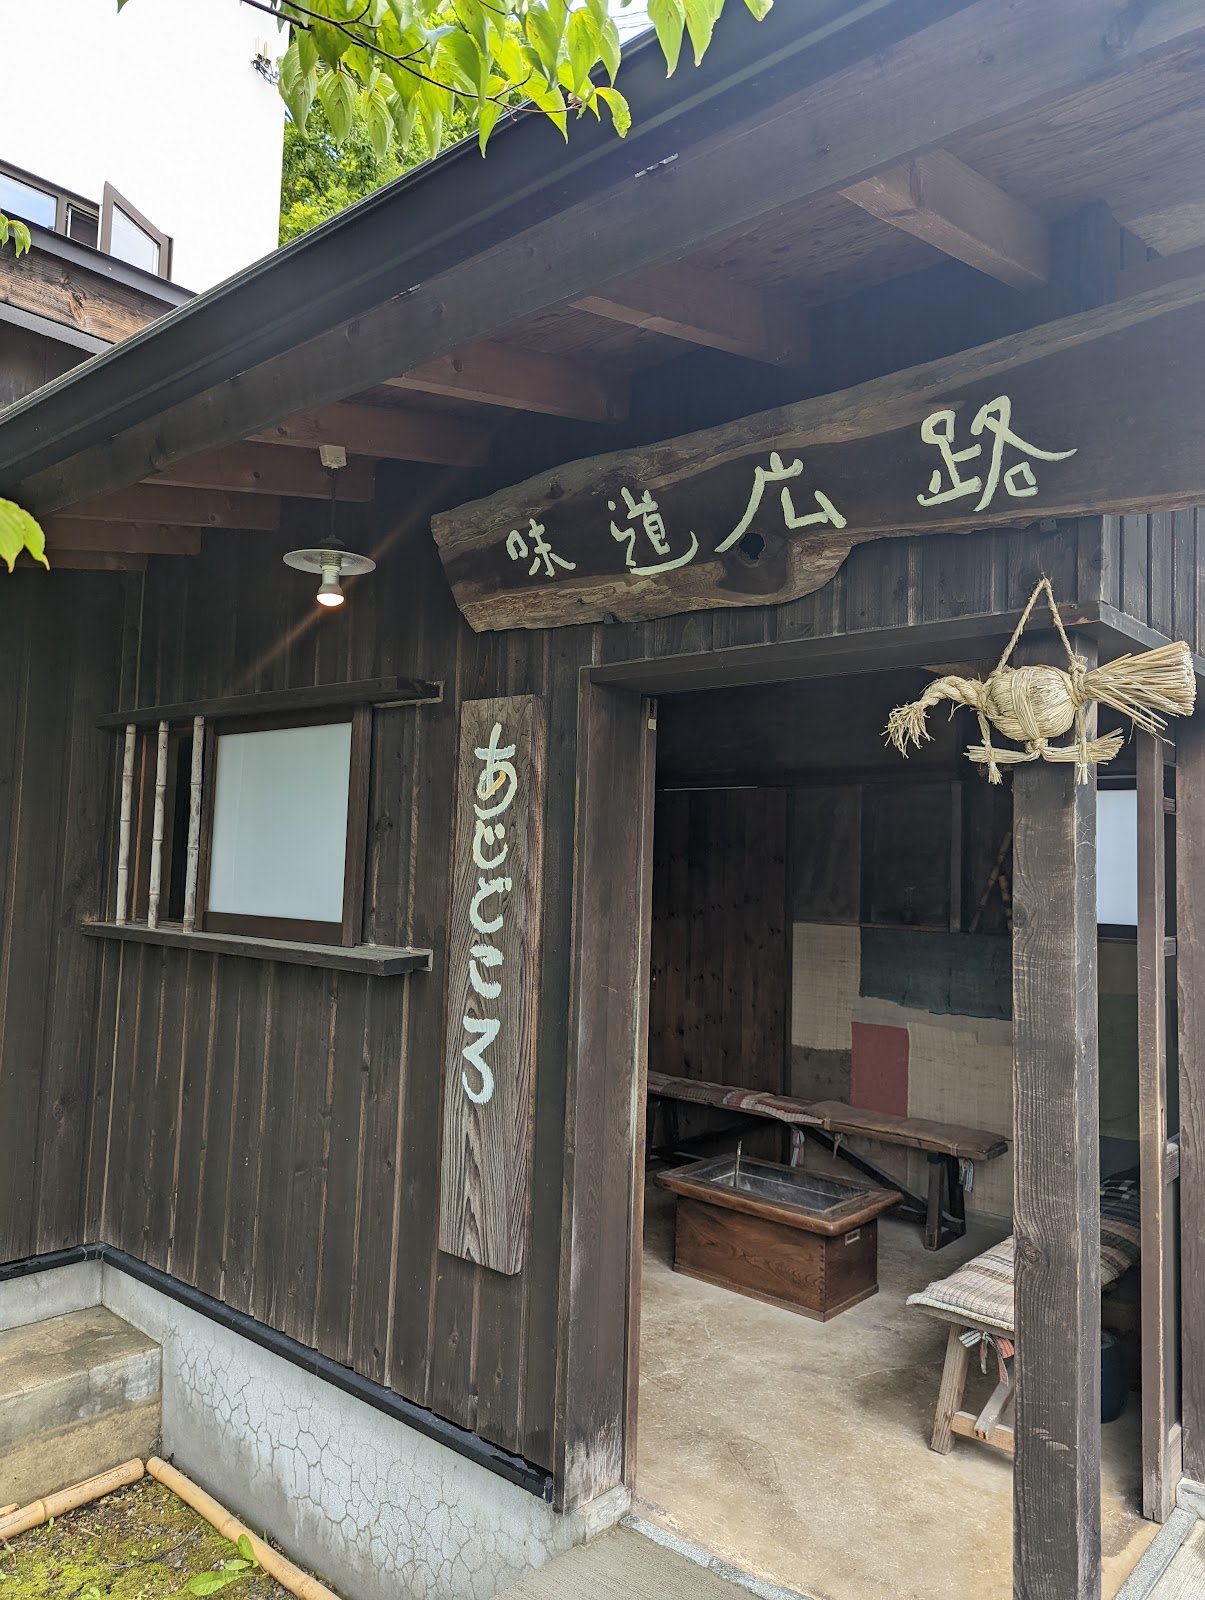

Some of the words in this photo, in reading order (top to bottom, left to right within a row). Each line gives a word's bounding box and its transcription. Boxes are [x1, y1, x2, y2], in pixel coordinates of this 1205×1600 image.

[505, 395, 1078, 577] 味道広路
[461, 722, 518, 1106] あじどころ
